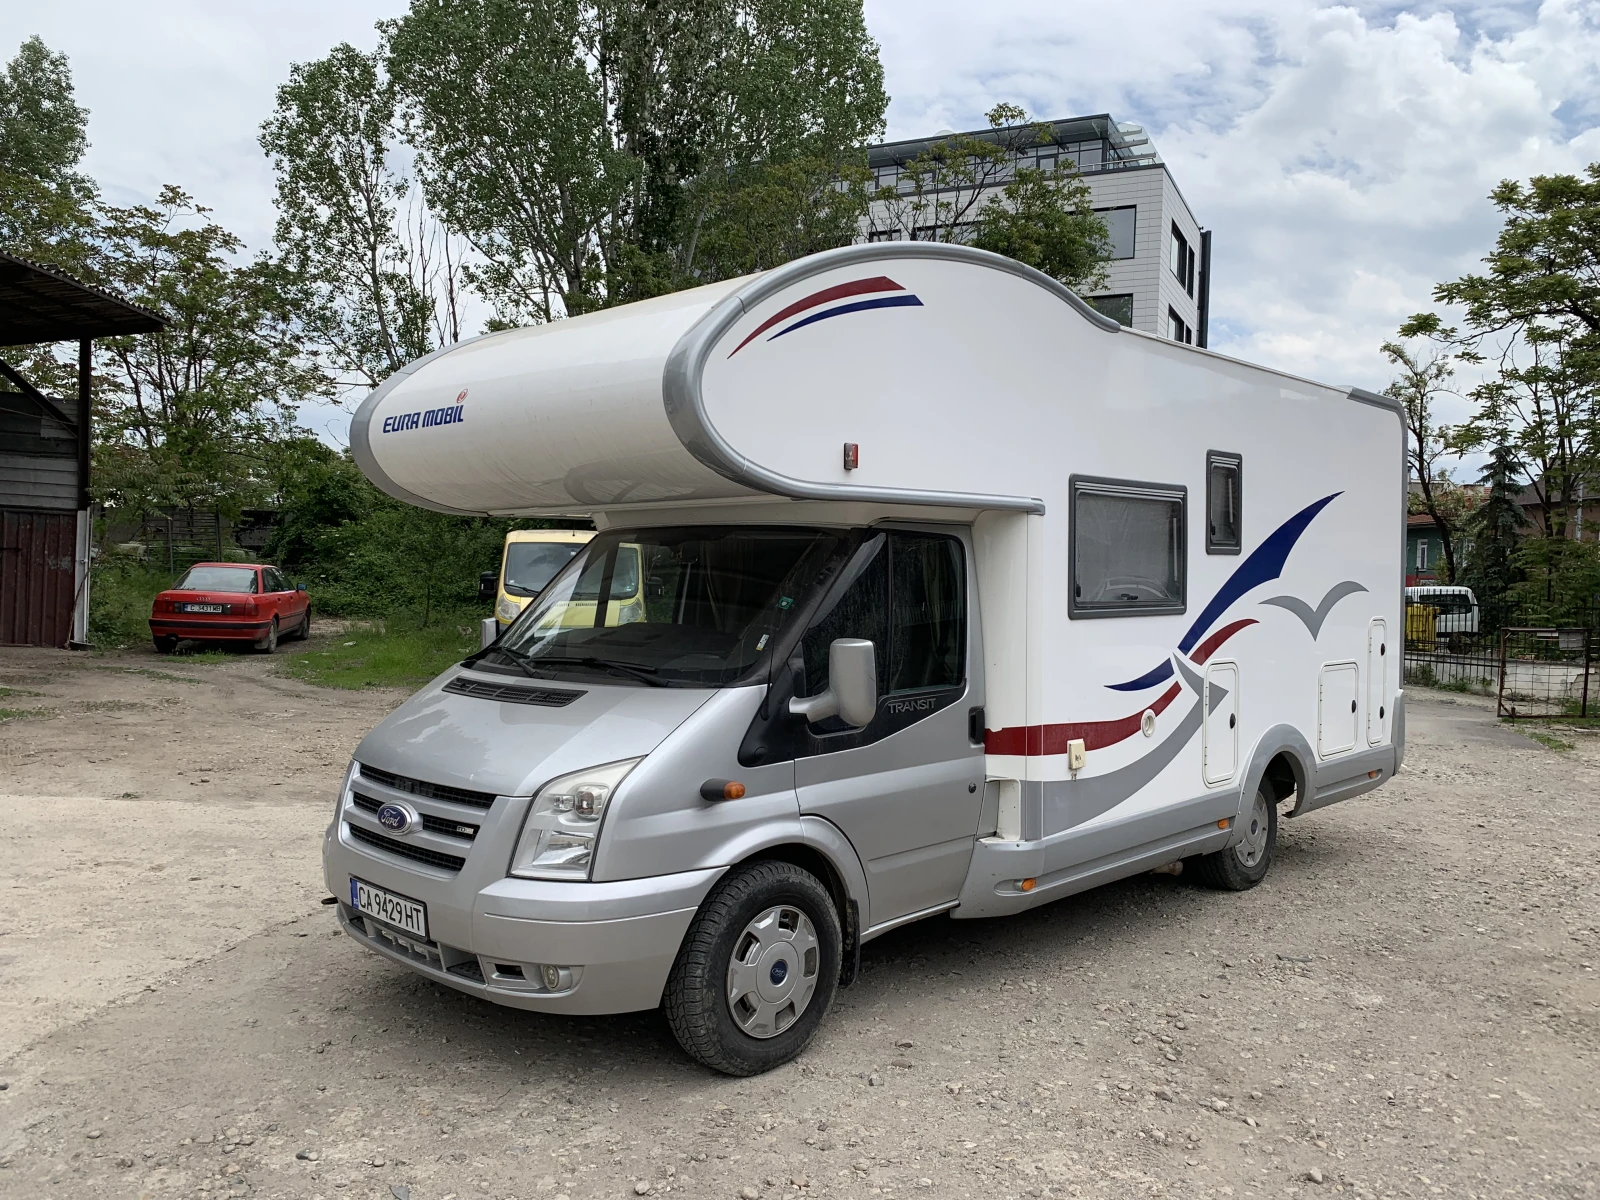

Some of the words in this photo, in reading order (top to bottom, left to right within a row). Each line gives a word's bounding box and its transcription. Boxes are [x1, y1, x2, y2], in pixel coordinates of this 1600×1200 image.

[382, 412, 422, 434] EURA
[422, 405, 464, 428] MOBIL
[887, 698, 936, 713] TRANSIT
[380, 808, 400, 827] Ford
[358, 886, 373, 913] CA
[374, 893, 402, 923] 9429
[404, 905, 421, 931] HT
